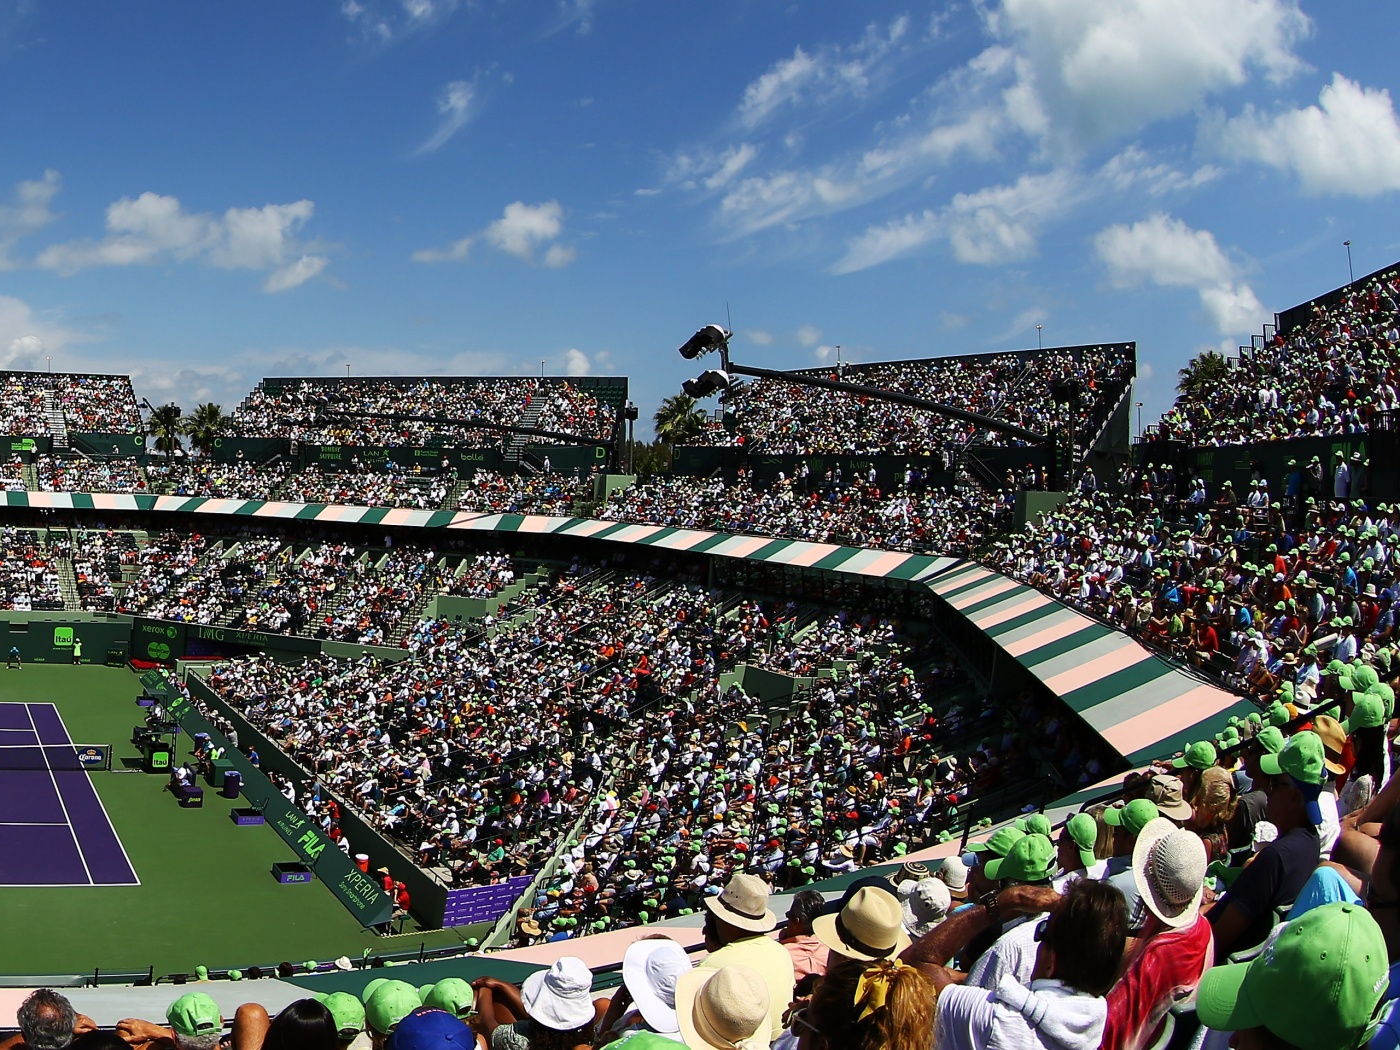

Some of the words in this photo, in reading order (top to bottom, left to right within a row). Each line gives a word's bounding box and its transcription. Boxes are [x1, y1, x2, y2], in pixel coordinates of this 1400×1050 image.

[134, 436, 143, 446] C
[214, 438, 222, 448] C
[595, 447, 605, 459] D
[142, 625, 165, 635] xerox
[198, 626, 225, 642] IMG
[55, 635, 72, 643] Itaú
[236, 631, 269, 643] XPERIA
[78, 753, 102, 762] Corona
[285, 811, 300, 824] LAN
[297, 829, 326, 859] FILA
[286, 874, 306, 882] FILA
[344, 868, 380, 905] XPERIA
[346, 888, 366, 910] Smartphone
